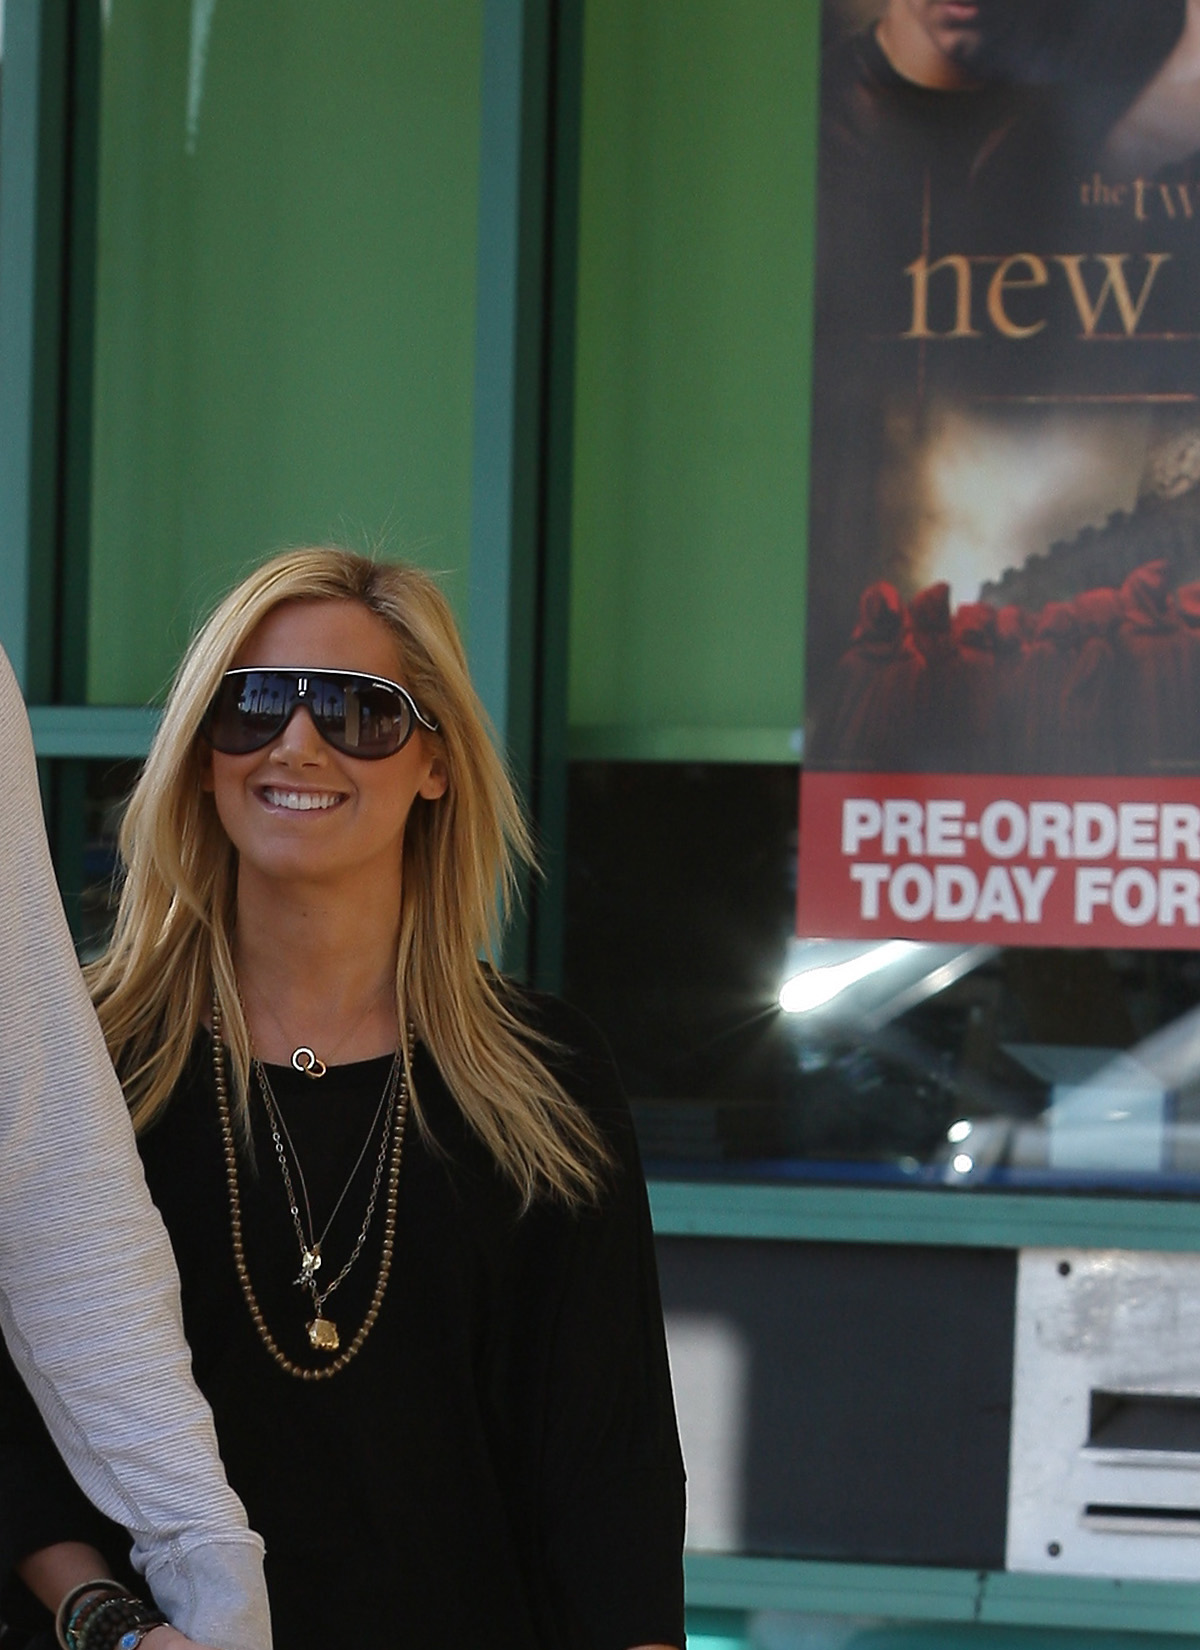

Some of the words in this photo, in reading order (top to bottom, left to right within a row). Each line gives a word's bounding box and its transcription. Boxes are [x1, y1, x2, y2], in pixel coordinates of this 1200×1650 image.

[1081, 172, 1127, 205] the
[901, 252, 1171, 339] new
[842, 798, 1200, 860] PRE-ORDER
[850, 862, 1056, 924] TODAY
[1075, 866, 1200, 926] FOR
